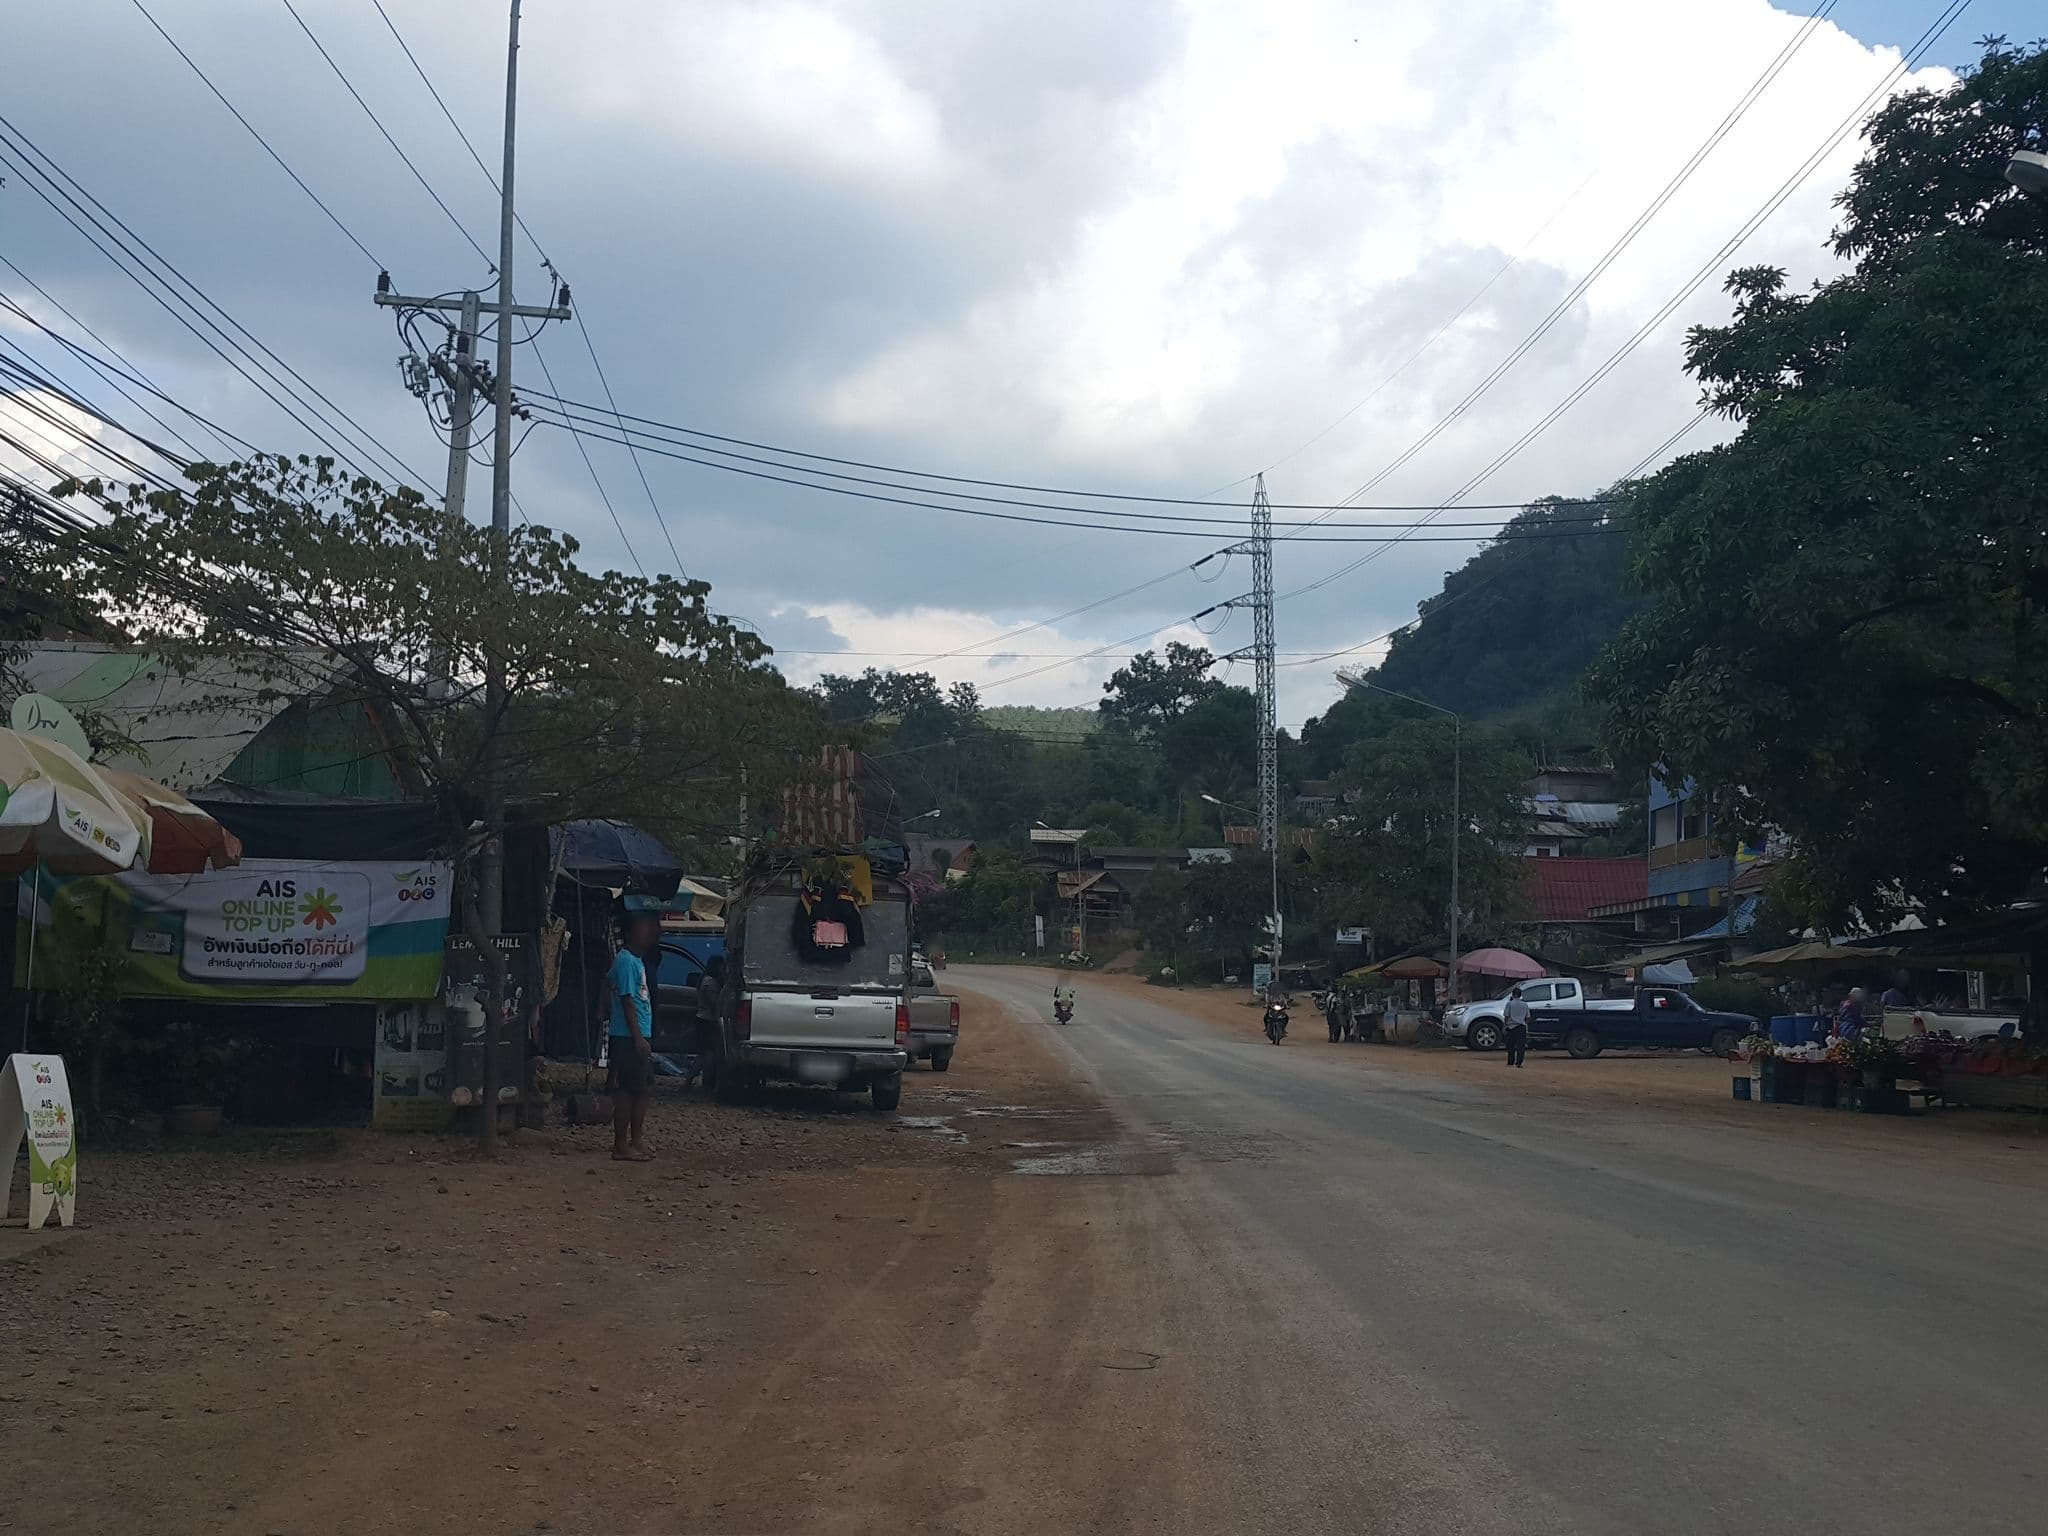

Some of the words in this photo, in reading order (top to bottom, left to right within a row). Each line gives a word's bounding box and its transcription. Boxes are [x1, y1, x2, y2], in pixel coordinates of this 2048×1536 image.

[74, 816, 89, 832] AIS
[256, 879, 296, 898] AIS
[414, 875, 436, 886] AIS
[222, 899, 296, 916] ONLINE
[222, 916, 263, 932] TOP
[268, 917, 296, 933] UP
[204, 933, 354, 956] อัพเงินมือถือได้ที่นี่!
[496, 937, 521, 949] HILL
[41, 1098, 53, 1109] AIS
